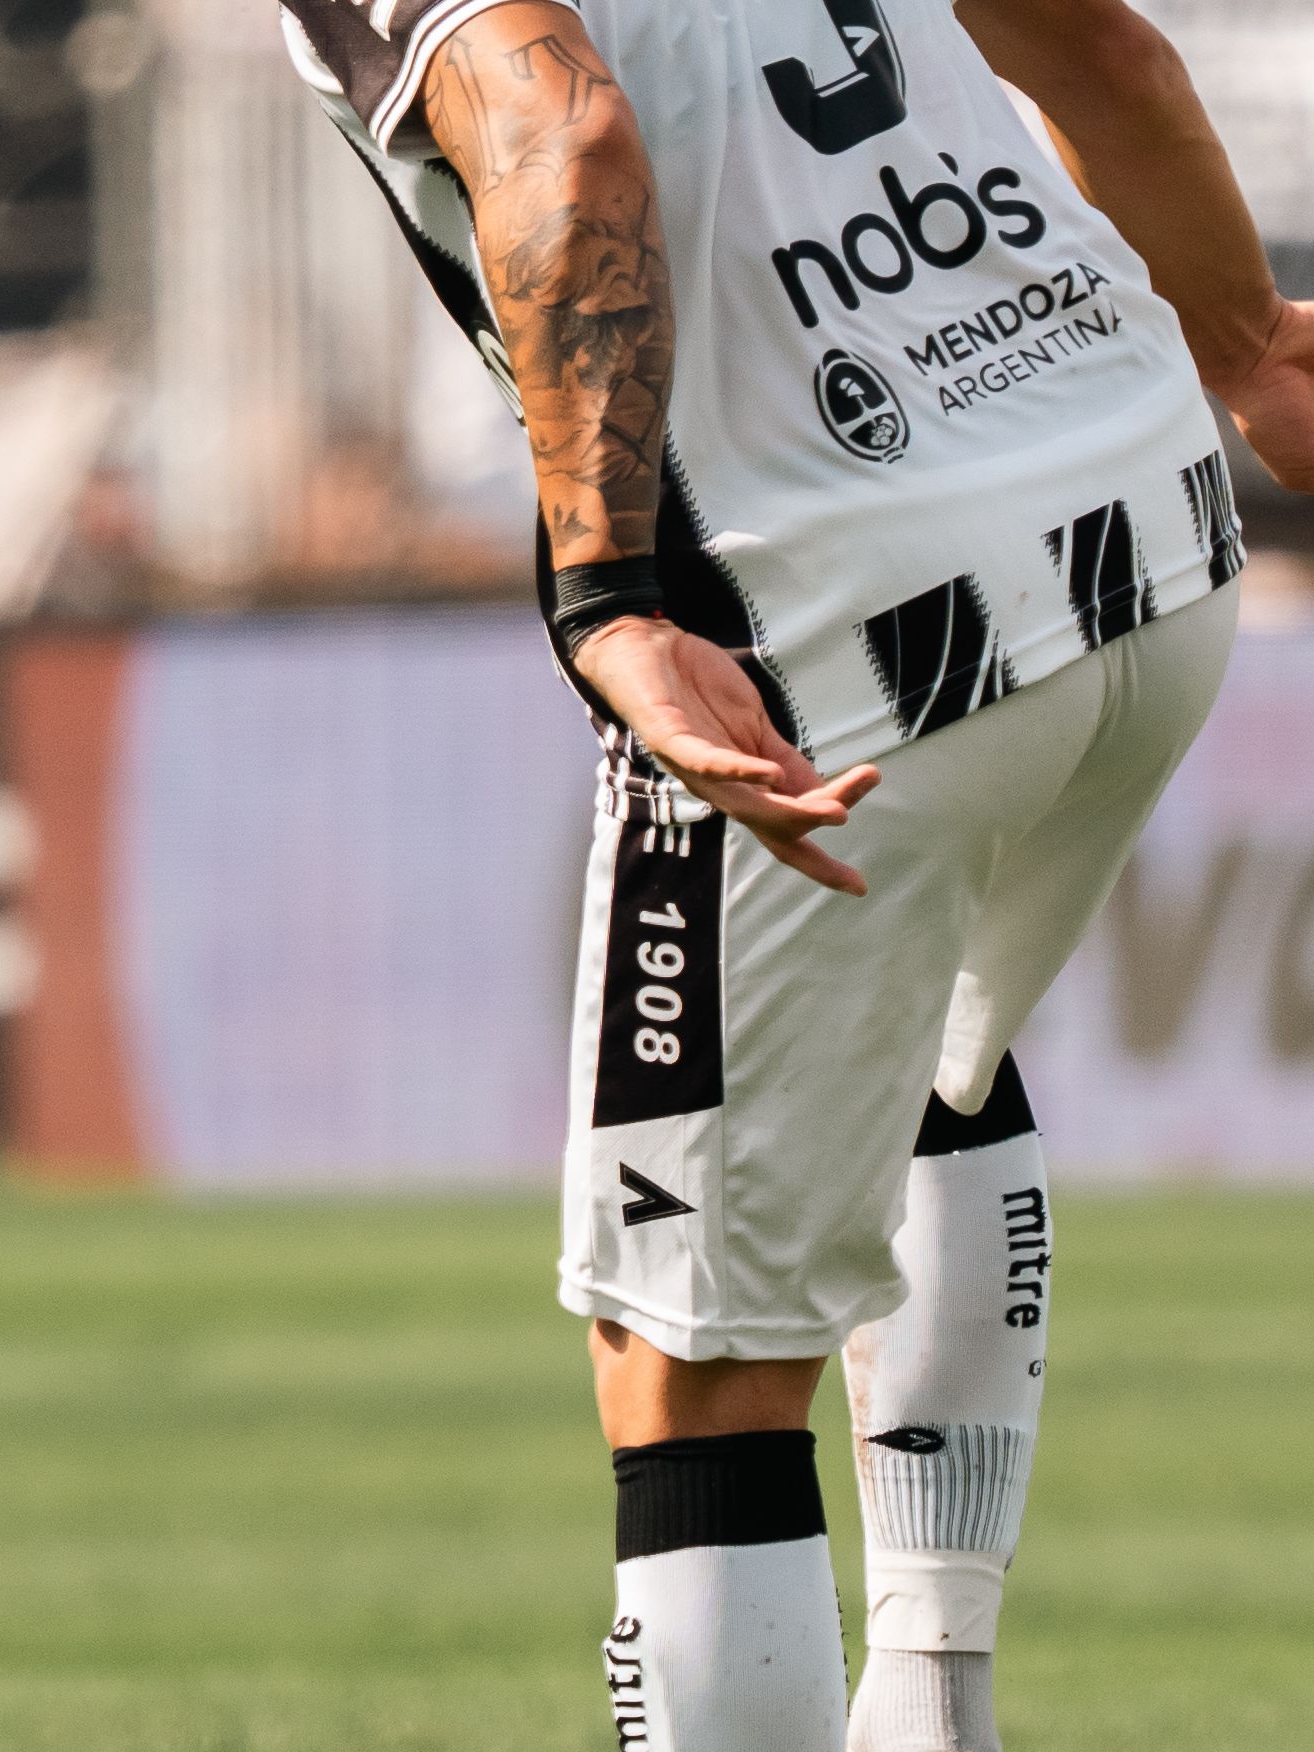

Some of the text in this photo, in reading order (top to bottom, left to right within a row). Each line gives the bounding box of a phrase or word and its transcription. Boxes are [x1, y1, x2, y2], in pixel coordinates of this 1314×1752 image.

[771, 151, 1047, 328] nob's
[903, 262, 1111, 376] MENDOZA
[634, 902, 686, 1064] 1908
[1002, 1187, 1051, 1328] mitre
